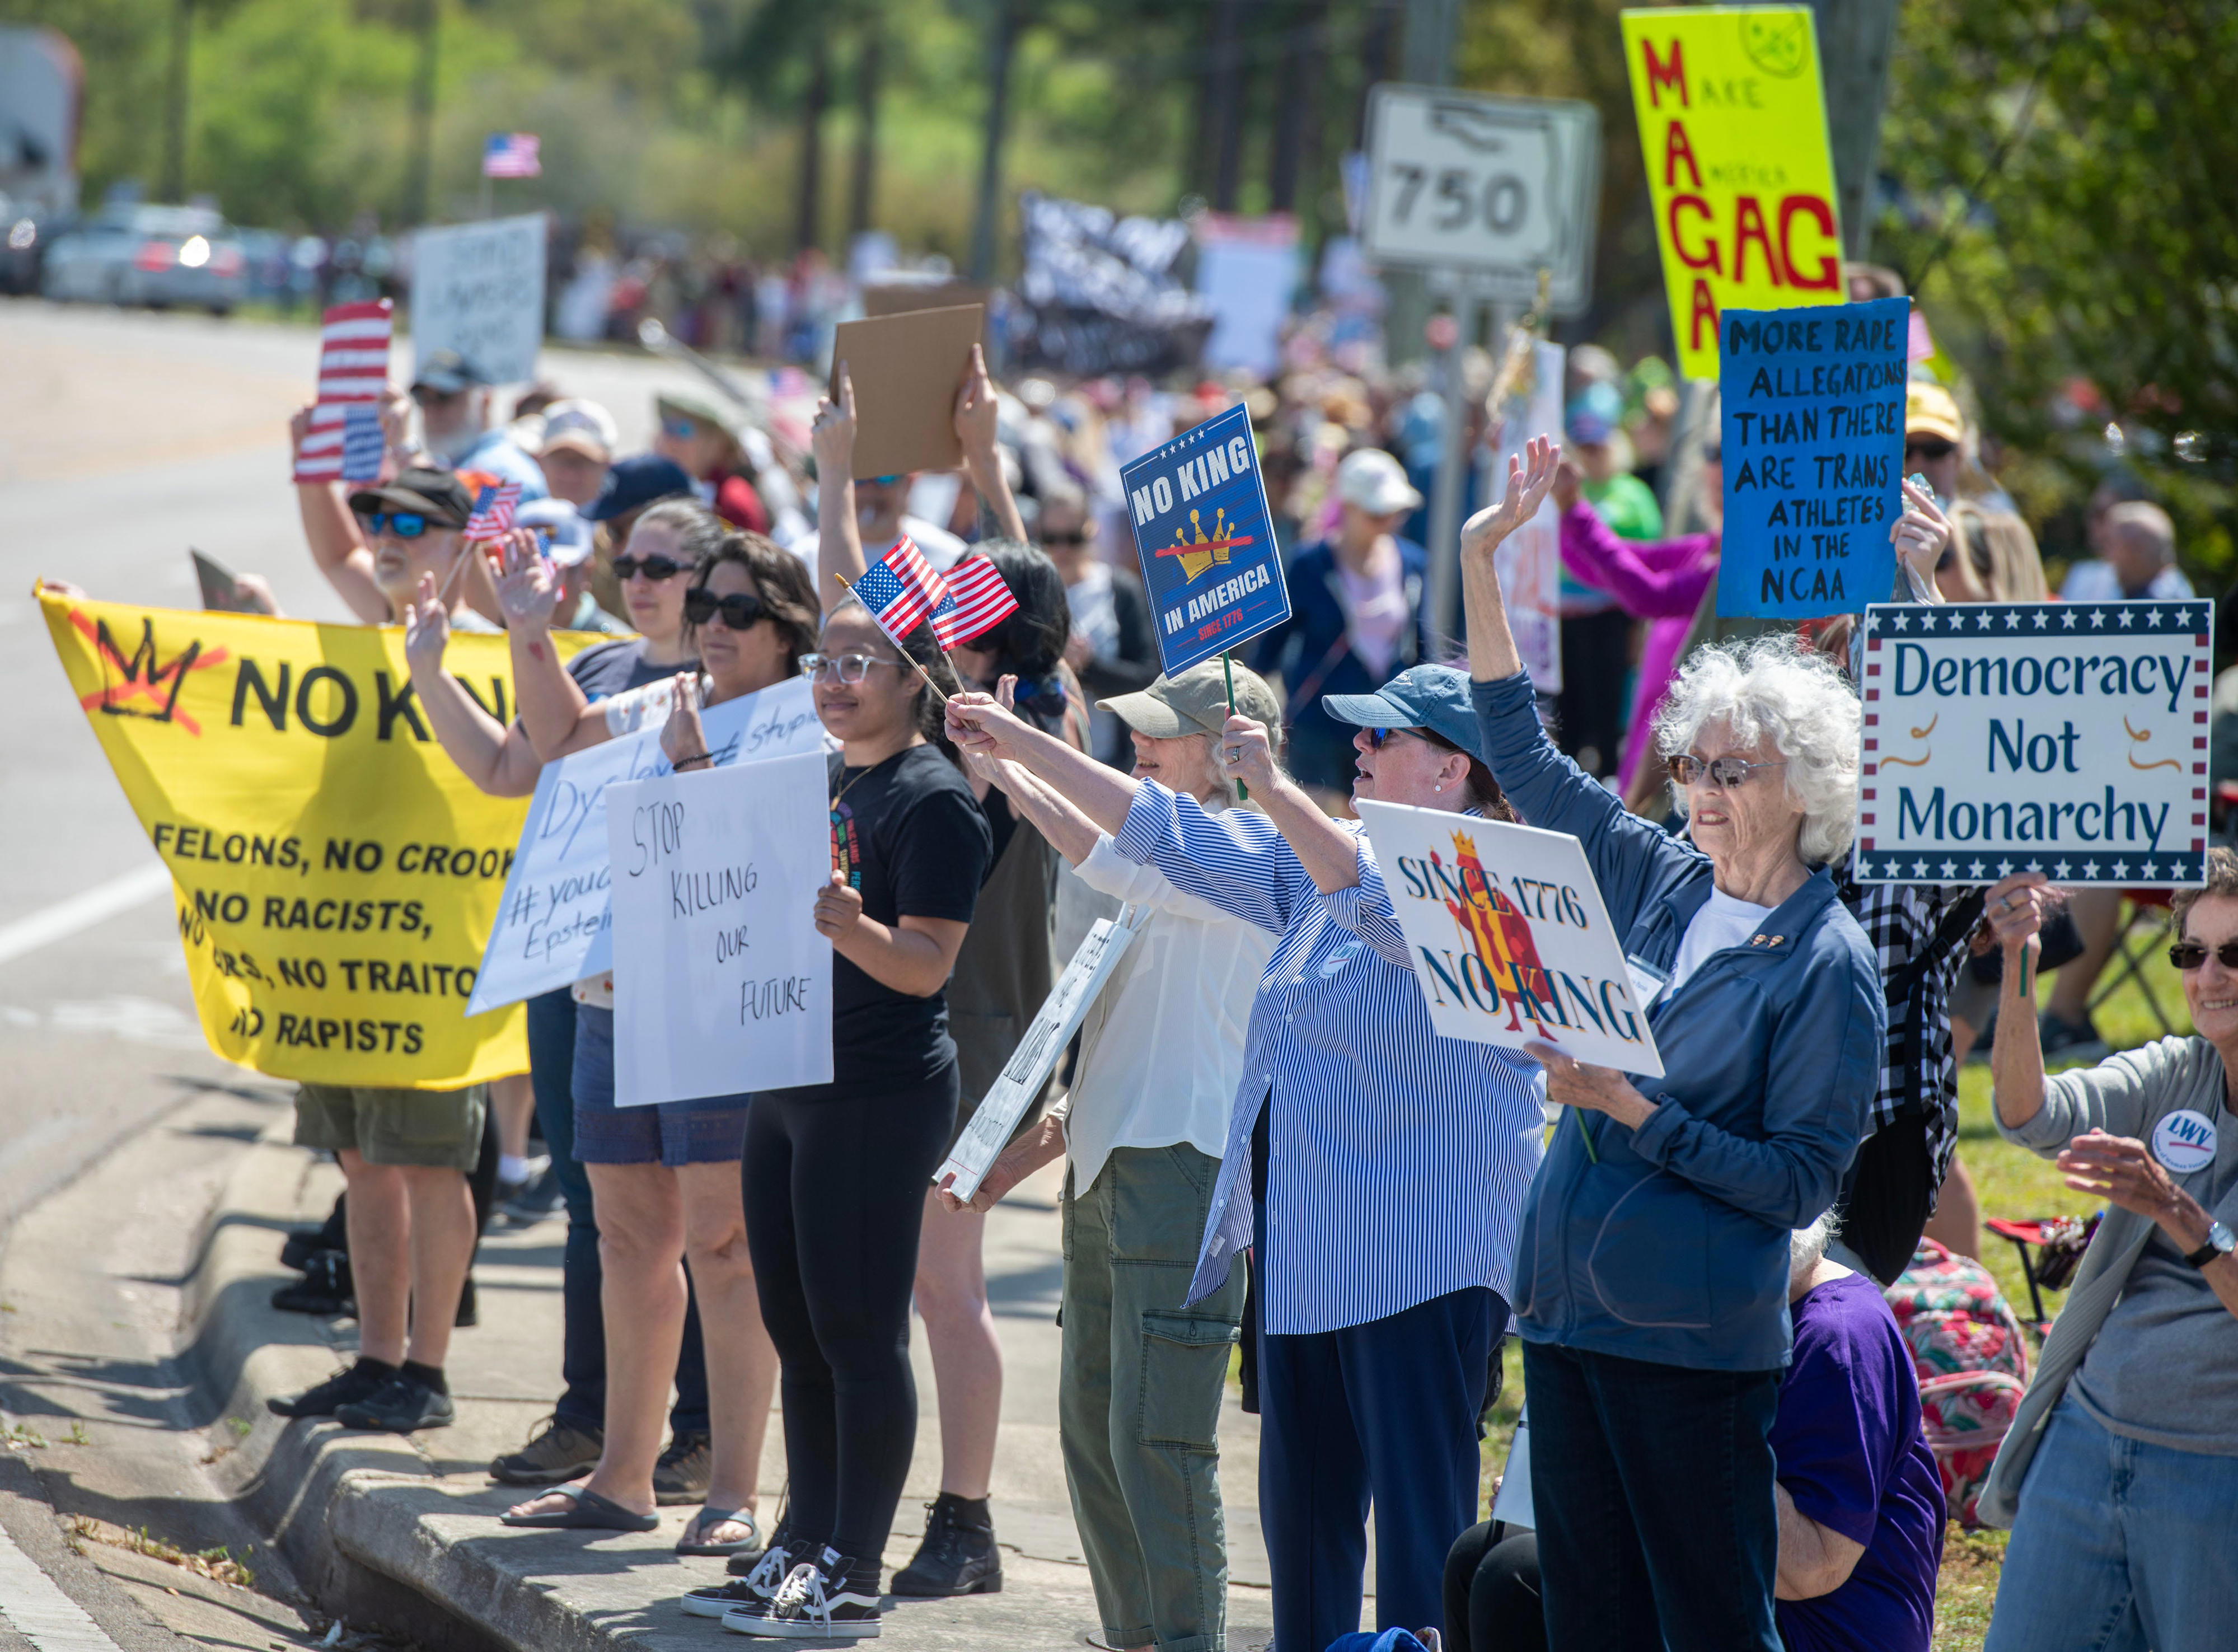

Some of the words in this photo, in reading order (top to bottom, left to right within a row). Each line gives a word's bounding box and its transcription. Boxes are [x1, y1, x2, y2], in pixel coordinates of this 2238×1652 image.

[1390, 166, 1528, 237] 750
[1730, 319, 1822, 355] MORE
[1834, 319, 1897, 353] RAPE
[1749, 359, 1905, 398] ALLEGATIONS
[1734, 406, 1818, 447] THAN
[1828, 402, 1897, 439] THERE
[1132, 476, 1173, 526] NO
[1177, 436, 1251, 502] KING
[1735, 455, 1795, 493] ARE
[1814, 453, 1889, 490] TRANS
[1768, 496, 1884, 528] ATHLETES
[1775, 534, 1801, 561] IN
[1812, 532, 1850, 559] THE
[1164, 613, 1184, 634] IN
[1189, 564, 1270, 623] AMERICA
[1761, 567, 1845, 604] NCAA
[1198, 619, 1221, 641] SINCE
[1223, 608, 1243, 631] 1776
[231, 659, 358, 737] NO
[1894, 642, 2191, 713] Democracy
[1988, 718, 2081, 773] Not
[629, 801, 685, 877] STOP
[1898, 785, 2170, 859] Monarchy
[153, 823, 310, 876] FELONS,
[324, 839, 382, 873] NO
[196, 889, 249, 923] NO
[263, 897, 433, 940] RACISTS,
[672, 862, 758, 919] KILLING
[1398, 855, 1511, 916] SINCE
[1511, 876, 1588, 930] 1776
[717, 925, 749, 963] OUR
[278, 958, 326, 989] NO
[1418, 945, 1502, 1016] NO
[1506, 961, 1644, 1044] KING
[741, 976, 812, 1026] FUTURE
[276, 1013, 423, 1055] RAPISTS
[2167, 1113, 2212, 1145] LWV
